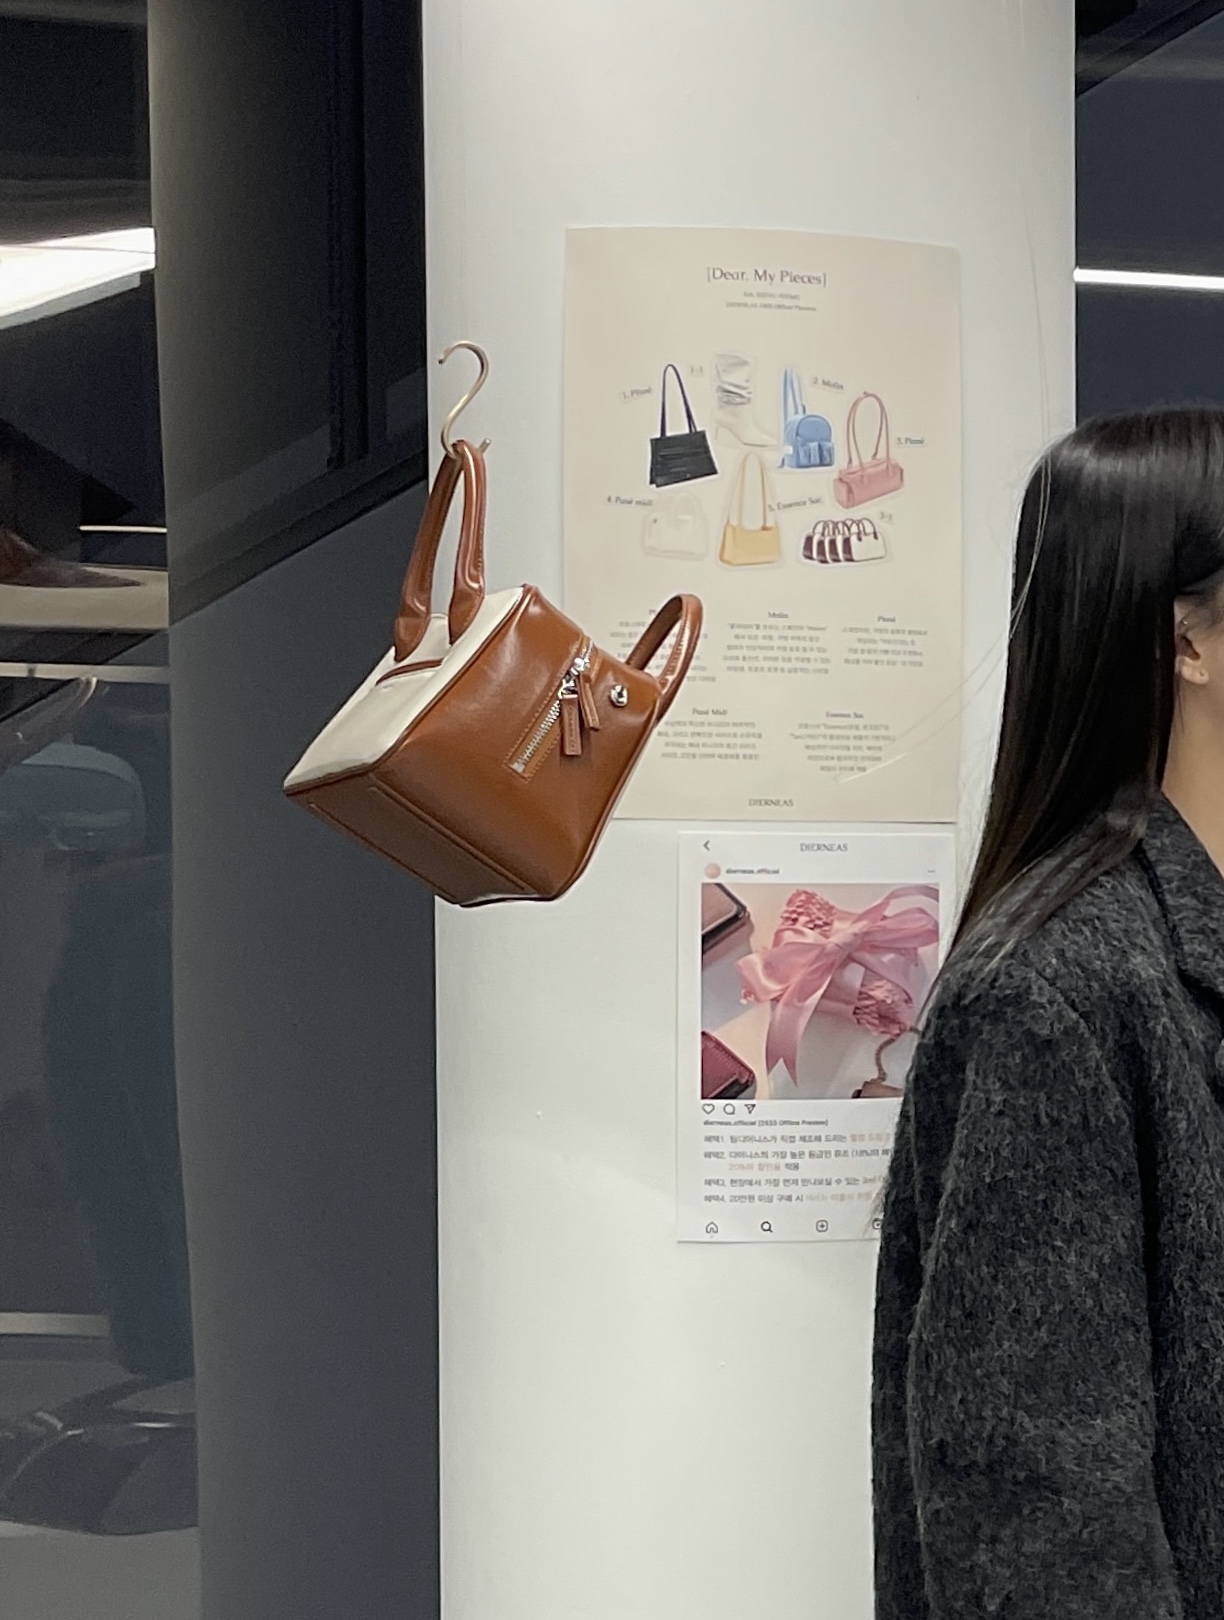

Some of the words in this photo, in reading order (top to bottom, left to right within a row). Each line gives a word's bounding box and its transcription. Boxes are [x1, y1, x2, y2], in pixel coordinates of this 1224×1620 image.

[754, 268, 776, 286] My
[780, 269, 827, 289] Pieces]
[748, 798, 795, 808] DIERNEAS
[800, 842, 849, 853] DIERNEAS
